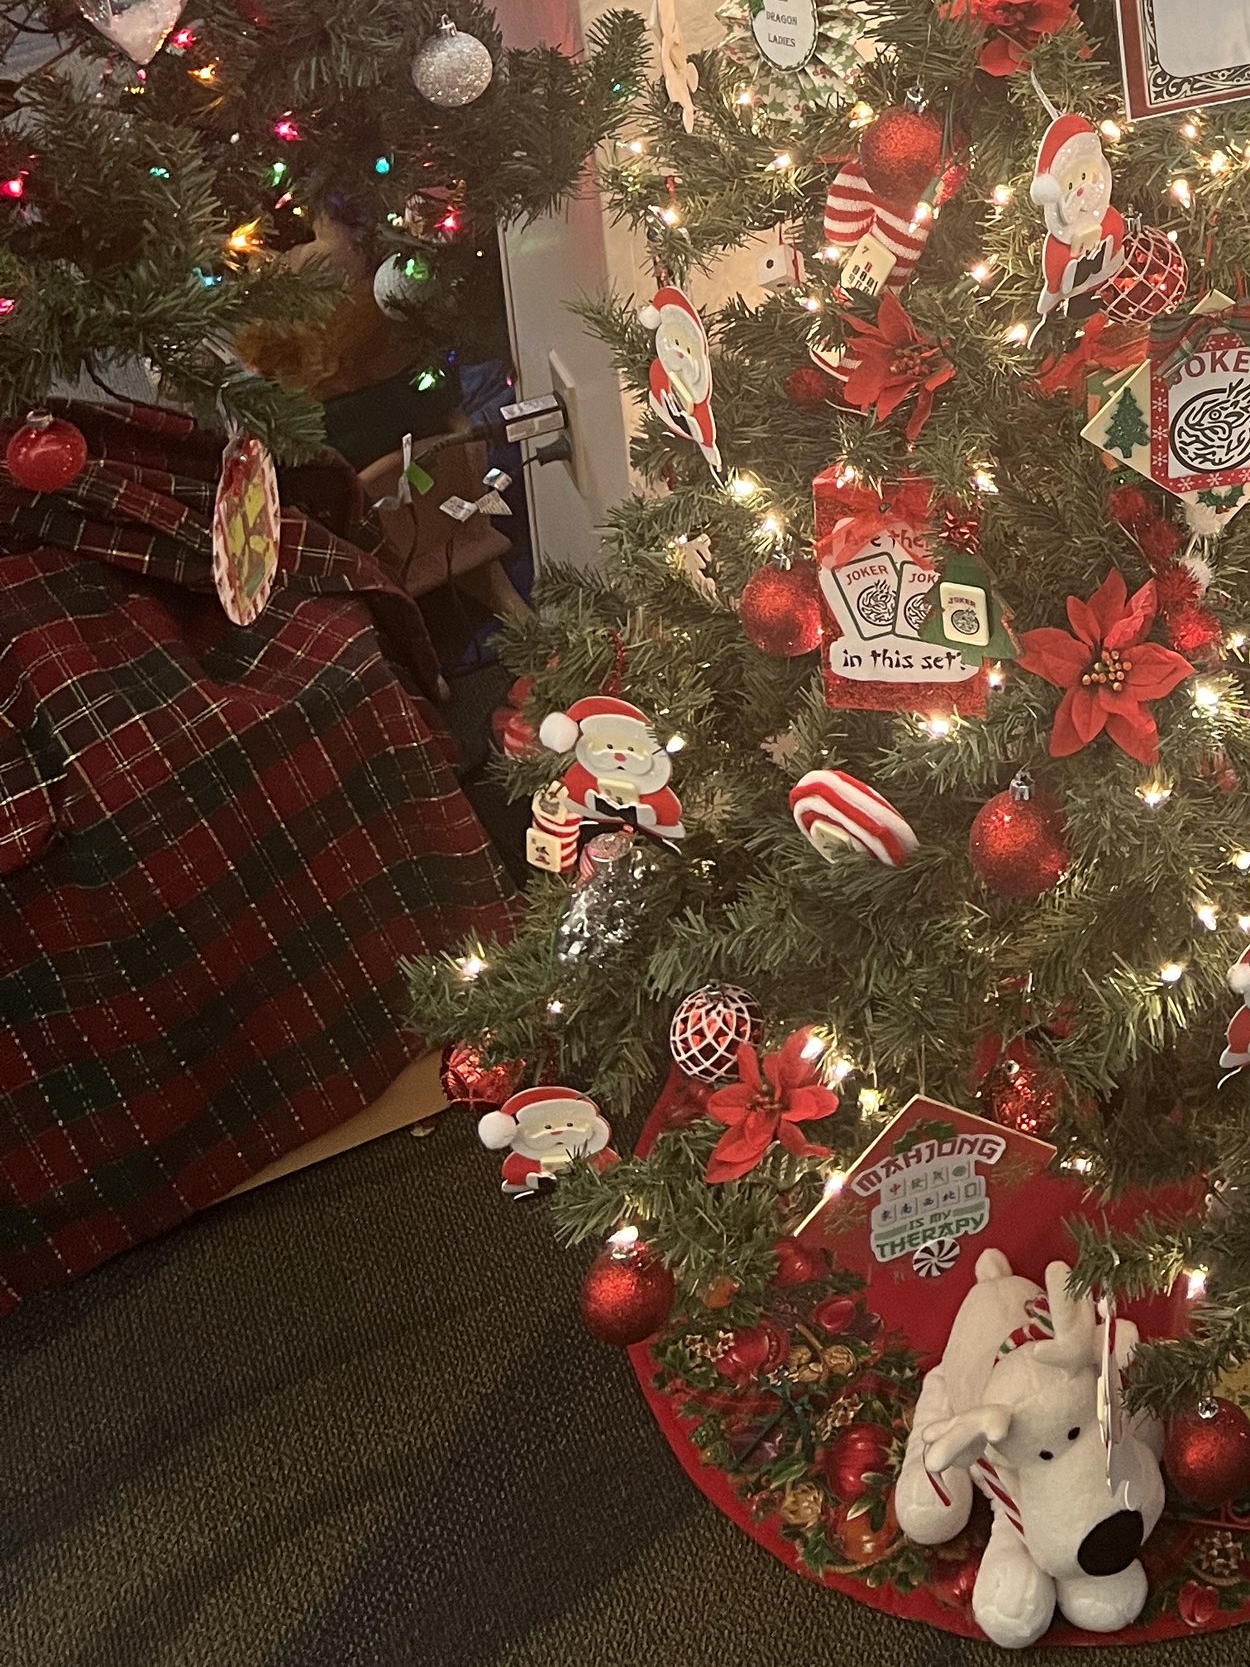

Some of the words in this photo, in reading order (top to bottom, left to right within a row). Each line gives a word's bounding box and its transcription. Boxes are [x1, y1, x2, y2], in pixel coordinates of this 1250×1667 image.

[766, 11, 798, 25] DRAGON
[768, 33, 796, 47] LADIES
[846, 564, 889, 585] JOKER
[948, 596, 976, 608] JOKER
[843, 649, 862, 668] in
[870, 649, 914, 670] this
[855, 1137, 1001, 1192] MAHJONG
[909, 1218, 925, 1231] IS
[876, 1213, 984, 1259] THERAPY
